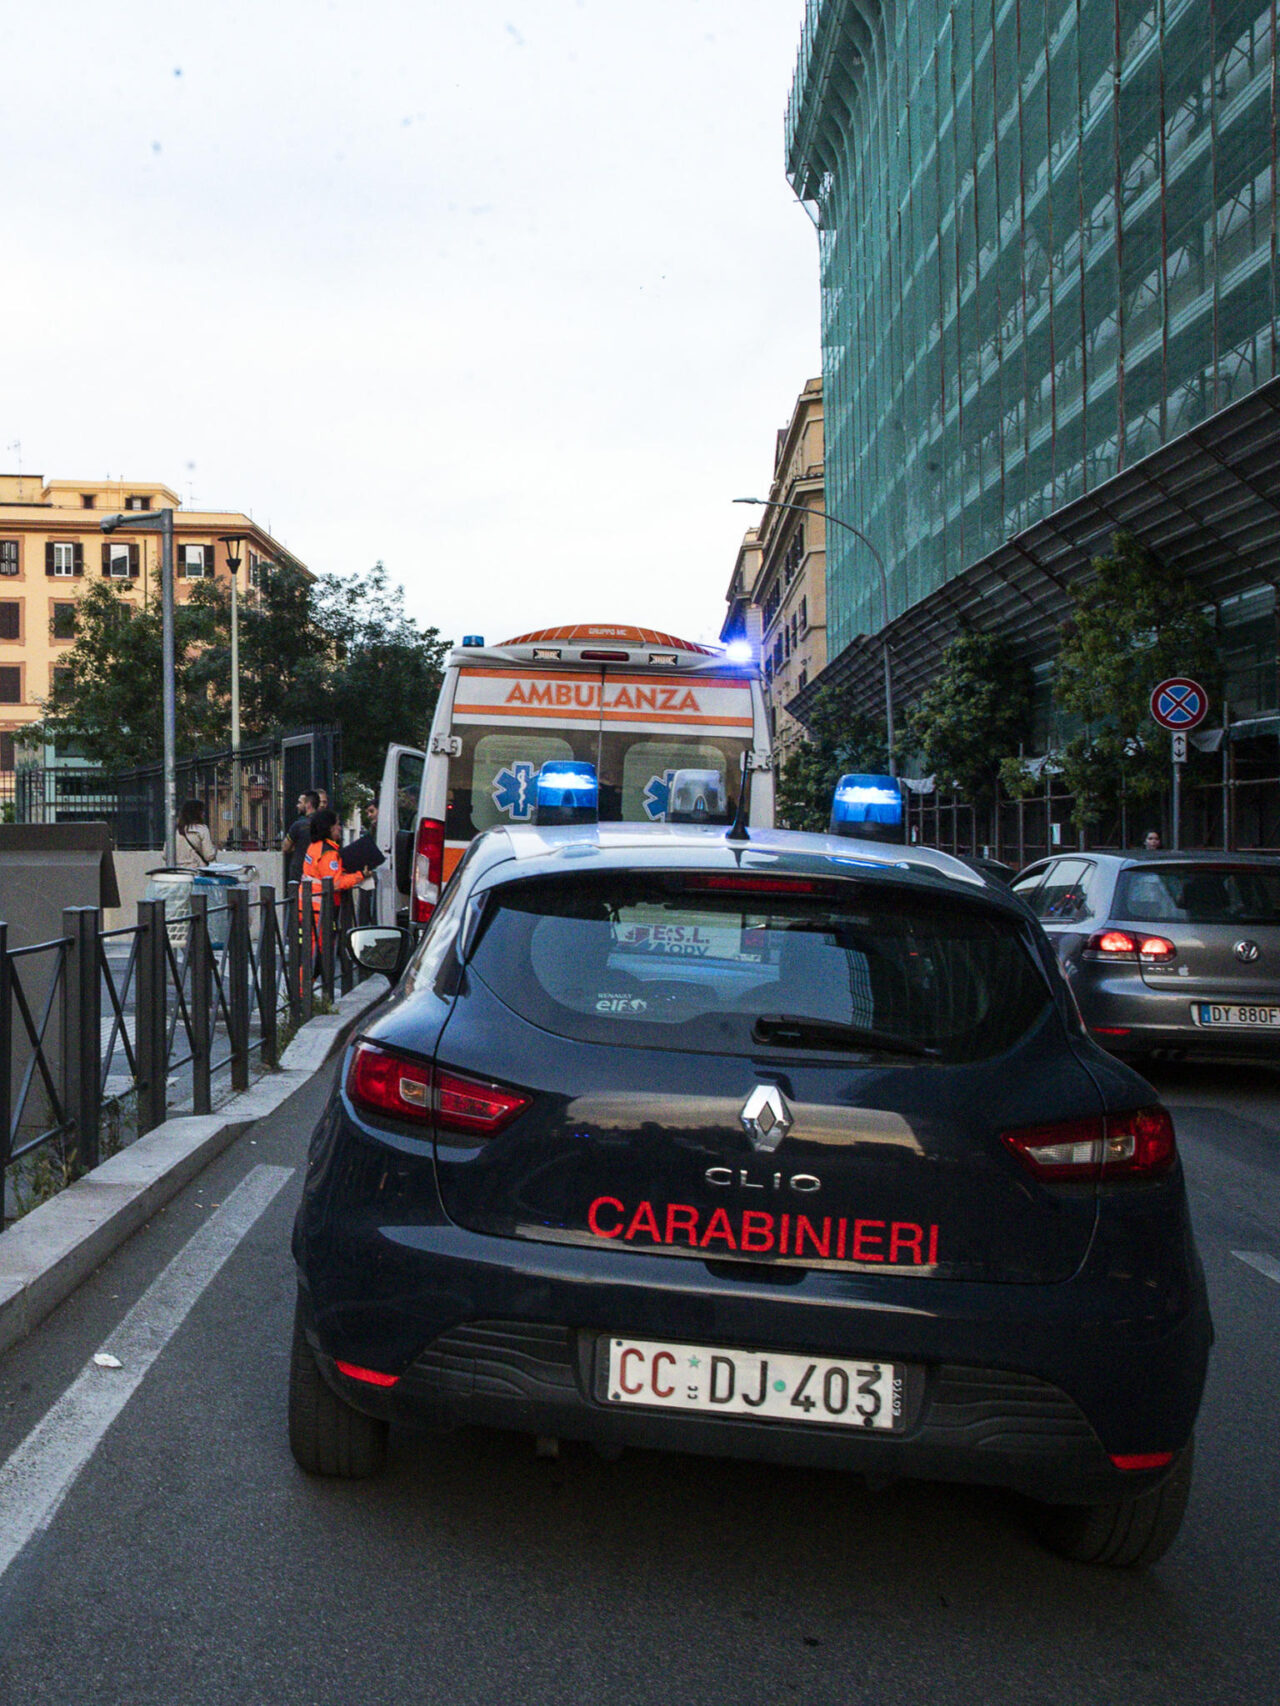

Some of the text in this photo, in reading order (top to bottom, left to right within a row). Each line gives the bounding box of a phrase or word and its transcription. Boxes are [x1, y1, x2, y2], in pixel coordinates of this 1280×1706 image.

[504, 681, 703, 712] AMBULANZA
[596, 999, 628, 1011] elf
[1212, 1007, 1232, 1021] DY
[705, 1167, 821, 1192] CLIO
[588, 1196, 939, 1265] CARABINIERI
[620, 1348, 882, 1417] CC DJ 403
